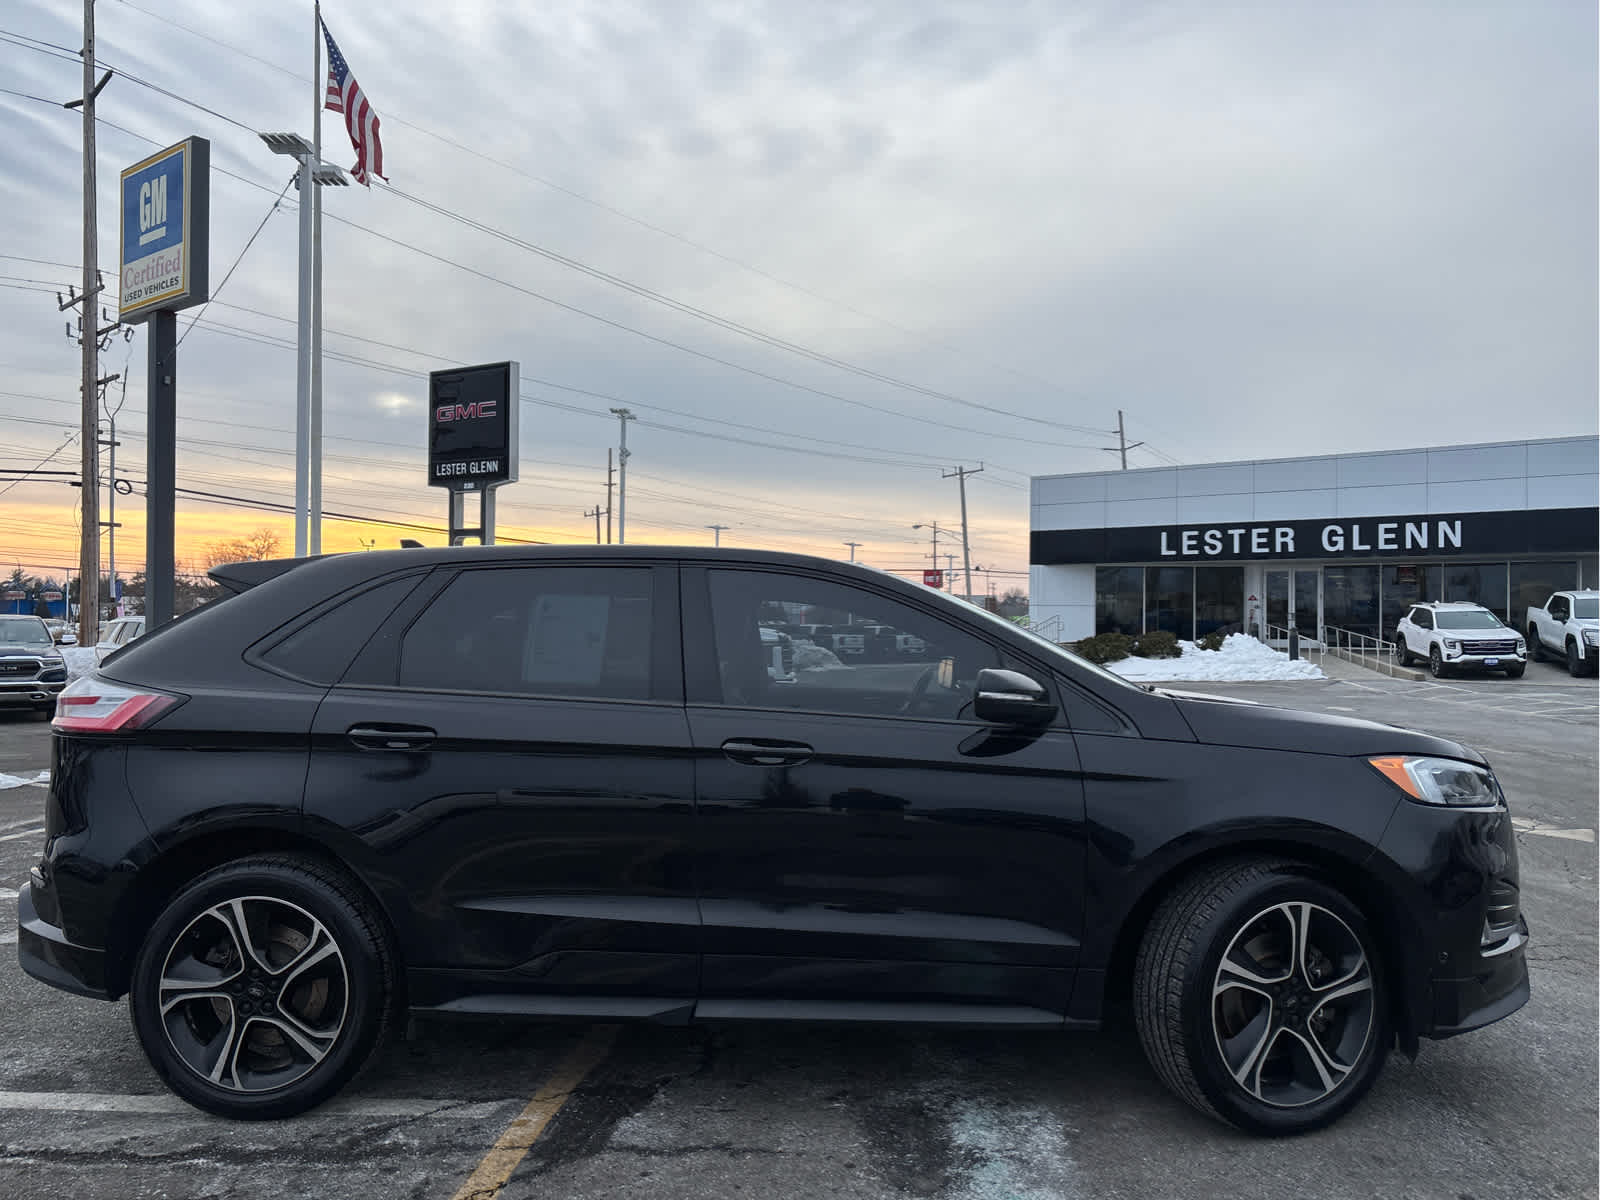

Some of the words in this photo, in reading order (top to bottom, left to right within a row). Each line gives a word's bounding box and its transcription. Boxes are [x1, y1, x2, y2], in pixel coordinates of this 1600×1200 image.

[139, 174, 168, 233] GM
[124, 247, 181, 289] Certified
[124, 288, 143, 302] USED
[144, 276, 180, 296] VEHICLES
[436, 400, 497, 423] GMC
[436, 462, 467, 476] LESTER
[469, 460, 499, 474] GLENN
[1160, 527, 1296, 556] LESTER
[1321, 520, 1462, 552] GLENN
